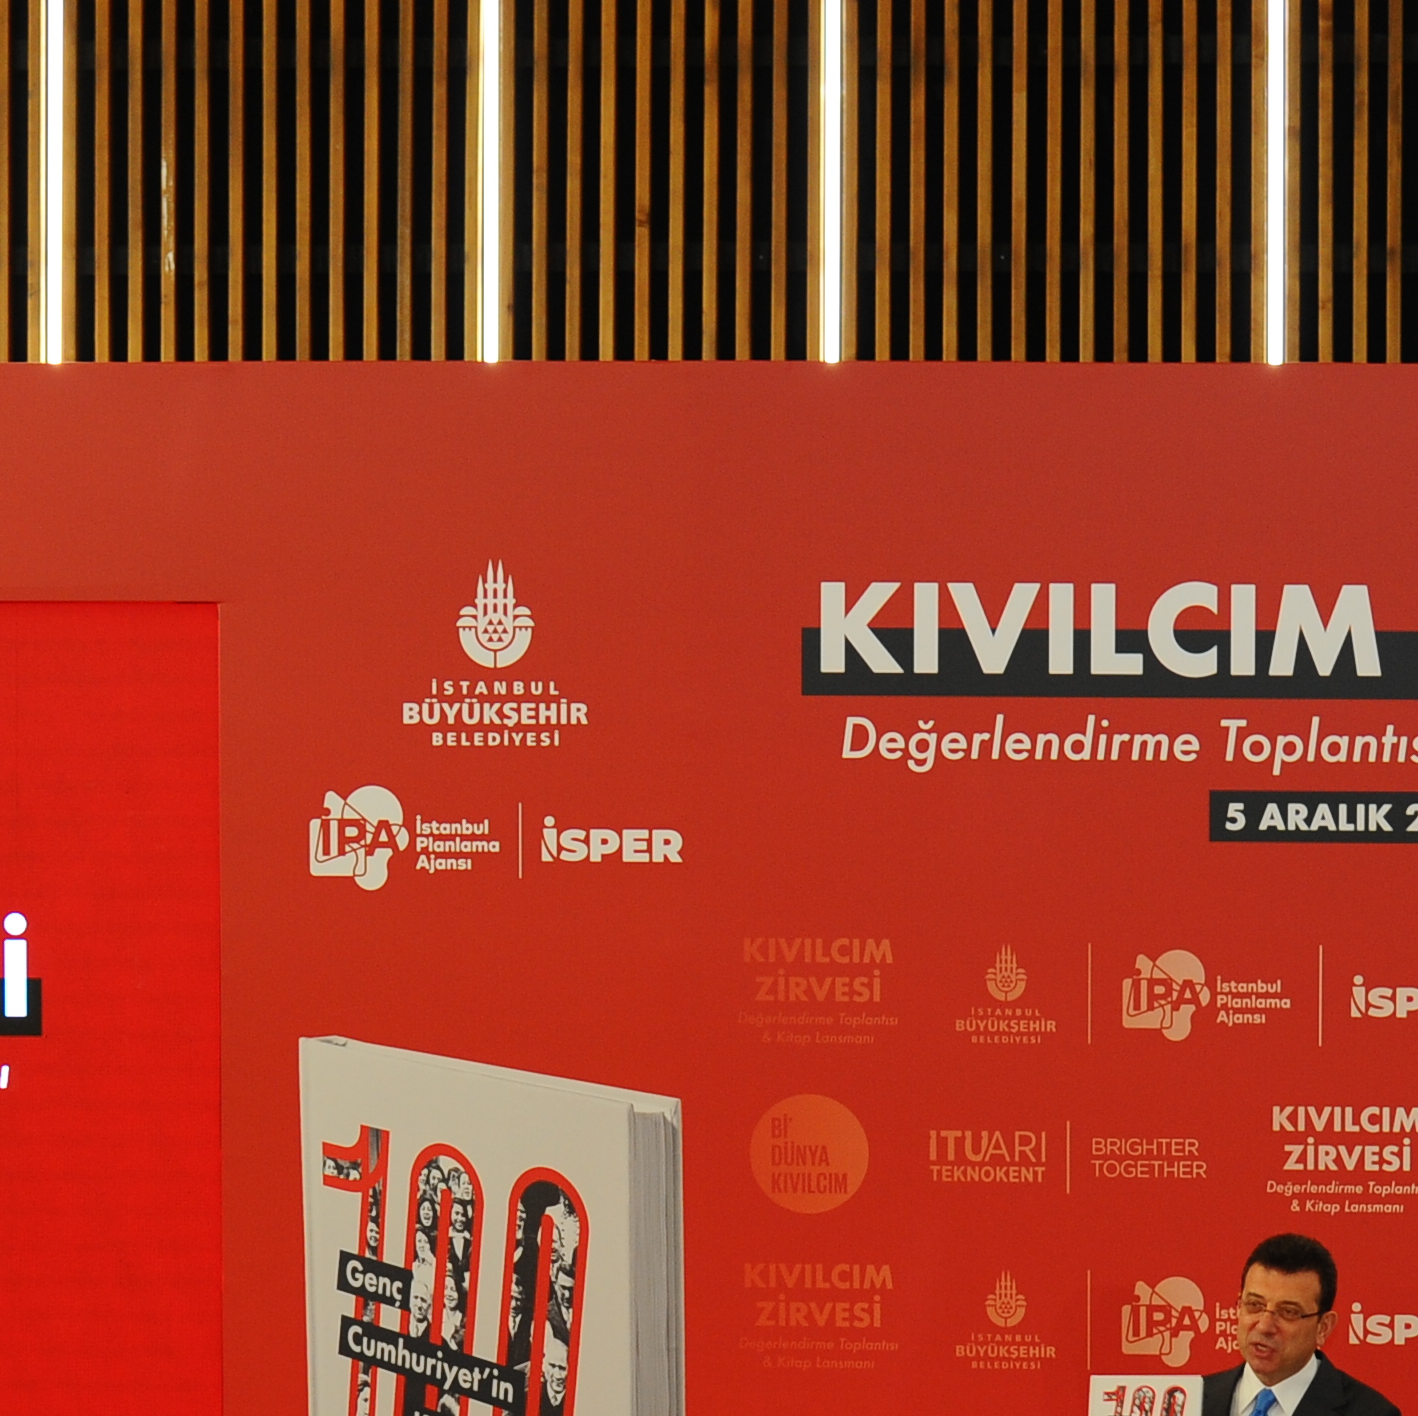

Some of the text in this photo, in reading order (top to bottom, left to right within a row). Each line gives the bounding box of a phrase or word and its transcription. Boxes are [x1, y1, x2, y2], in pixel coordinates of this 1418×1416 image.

[821, 582, 1381, 677] KIVILCIM
[432, 679, 559, 695] İSTANBUL
[403, 699, 587, 726] BÜYÜKŞEHİR
[432, 730, 559, 746] BELEDİYESİ
[842, 714, 1199, 772] Değerlendirme
[416, 815, 488, 835] İstanbul
[1226, 803, 1245, 830] 5
[1259, 803, 1392, 831] ARALIK
[416, 837, 499, 852] Planlama
[542, 816, 682, 862] İSPER
[416, 854, 471, 873] Ajansı
[1217, 976, 1281, 993] İstanbul
[956, 1018, 1056, 1032] BÜYÜKŞEHİR
[1217, 1011, 1265, 1027] Ajansı
[1092, 1138, 1199, 1156] BRIGHTER
[1284, 1137, 1410, 1171] ZİRVESİ
[930, 1165, 1045, 1182] TEKNOKENT
[1091, 1160, 1207, 1178] TOGETHER
[1267, 1180, 1363, 1196] Değerlendirme
[1291, 1199, 1300, 1211] &
[1306, 1200, 1340, 1215] Kitap
[345, 1260, 403, 1307] Genç
[956, 1343, 1055, 1358] BÜYÜKŞEHİR
[347, 1325, 514, 1403] Cumhuriyet'in
